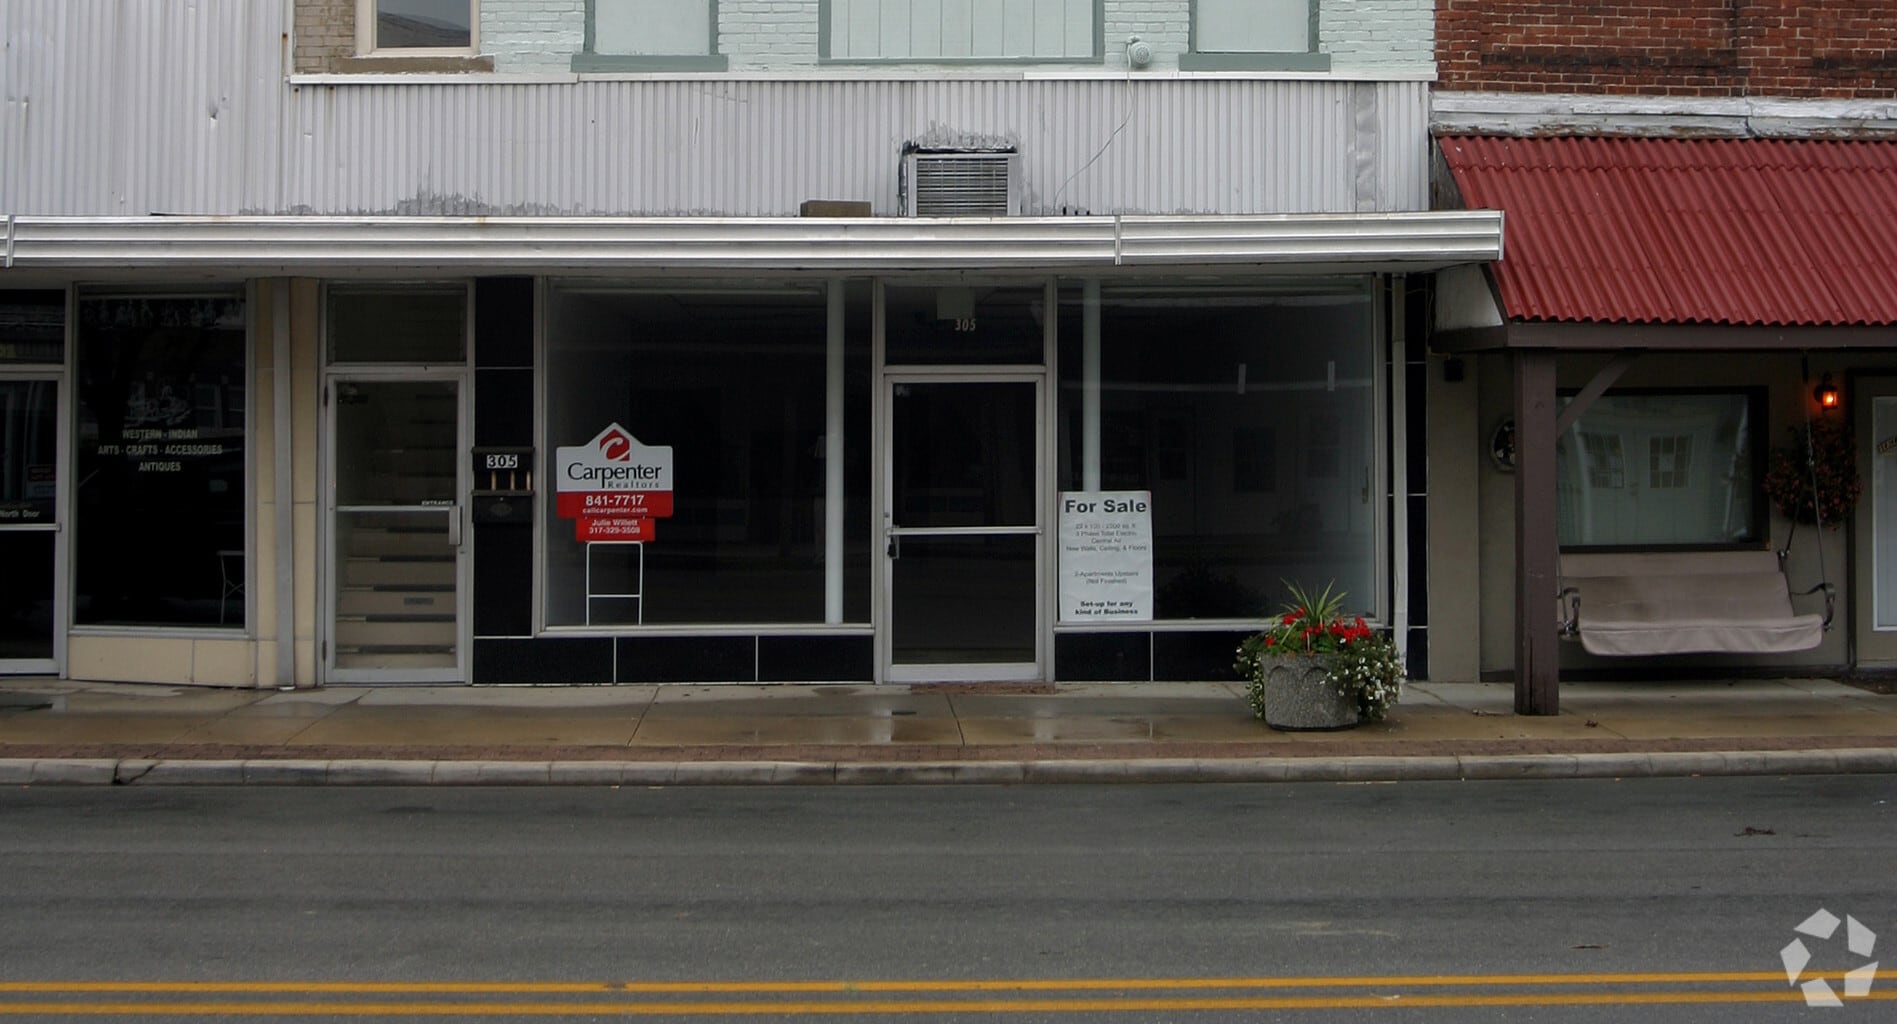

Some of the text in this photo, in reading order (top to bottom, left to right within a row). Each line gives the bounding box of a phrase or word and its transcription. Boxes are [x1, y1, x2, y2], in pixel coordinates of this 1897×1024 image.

[954, 319, 976, 332] 305
[122, 429, 162, 439] WESTERN
[168, 429, 198, 439] INDIAN
[97, 445, 120, 455] ARTS
[126, 445, 159, 455] CRAFTS
[164, 444, 223, 455] ACCESSORIES
[488, 455, 516, 467] 305
[138, 462, 182, 472] ANTIQUES
[567, 462, 662, 488] Carpenter
[585, 495, 645, 506] 841-7717
[1065, 499, 1147, 513] For Sale
[583, 507, 648, 515] callcarpenter.com
